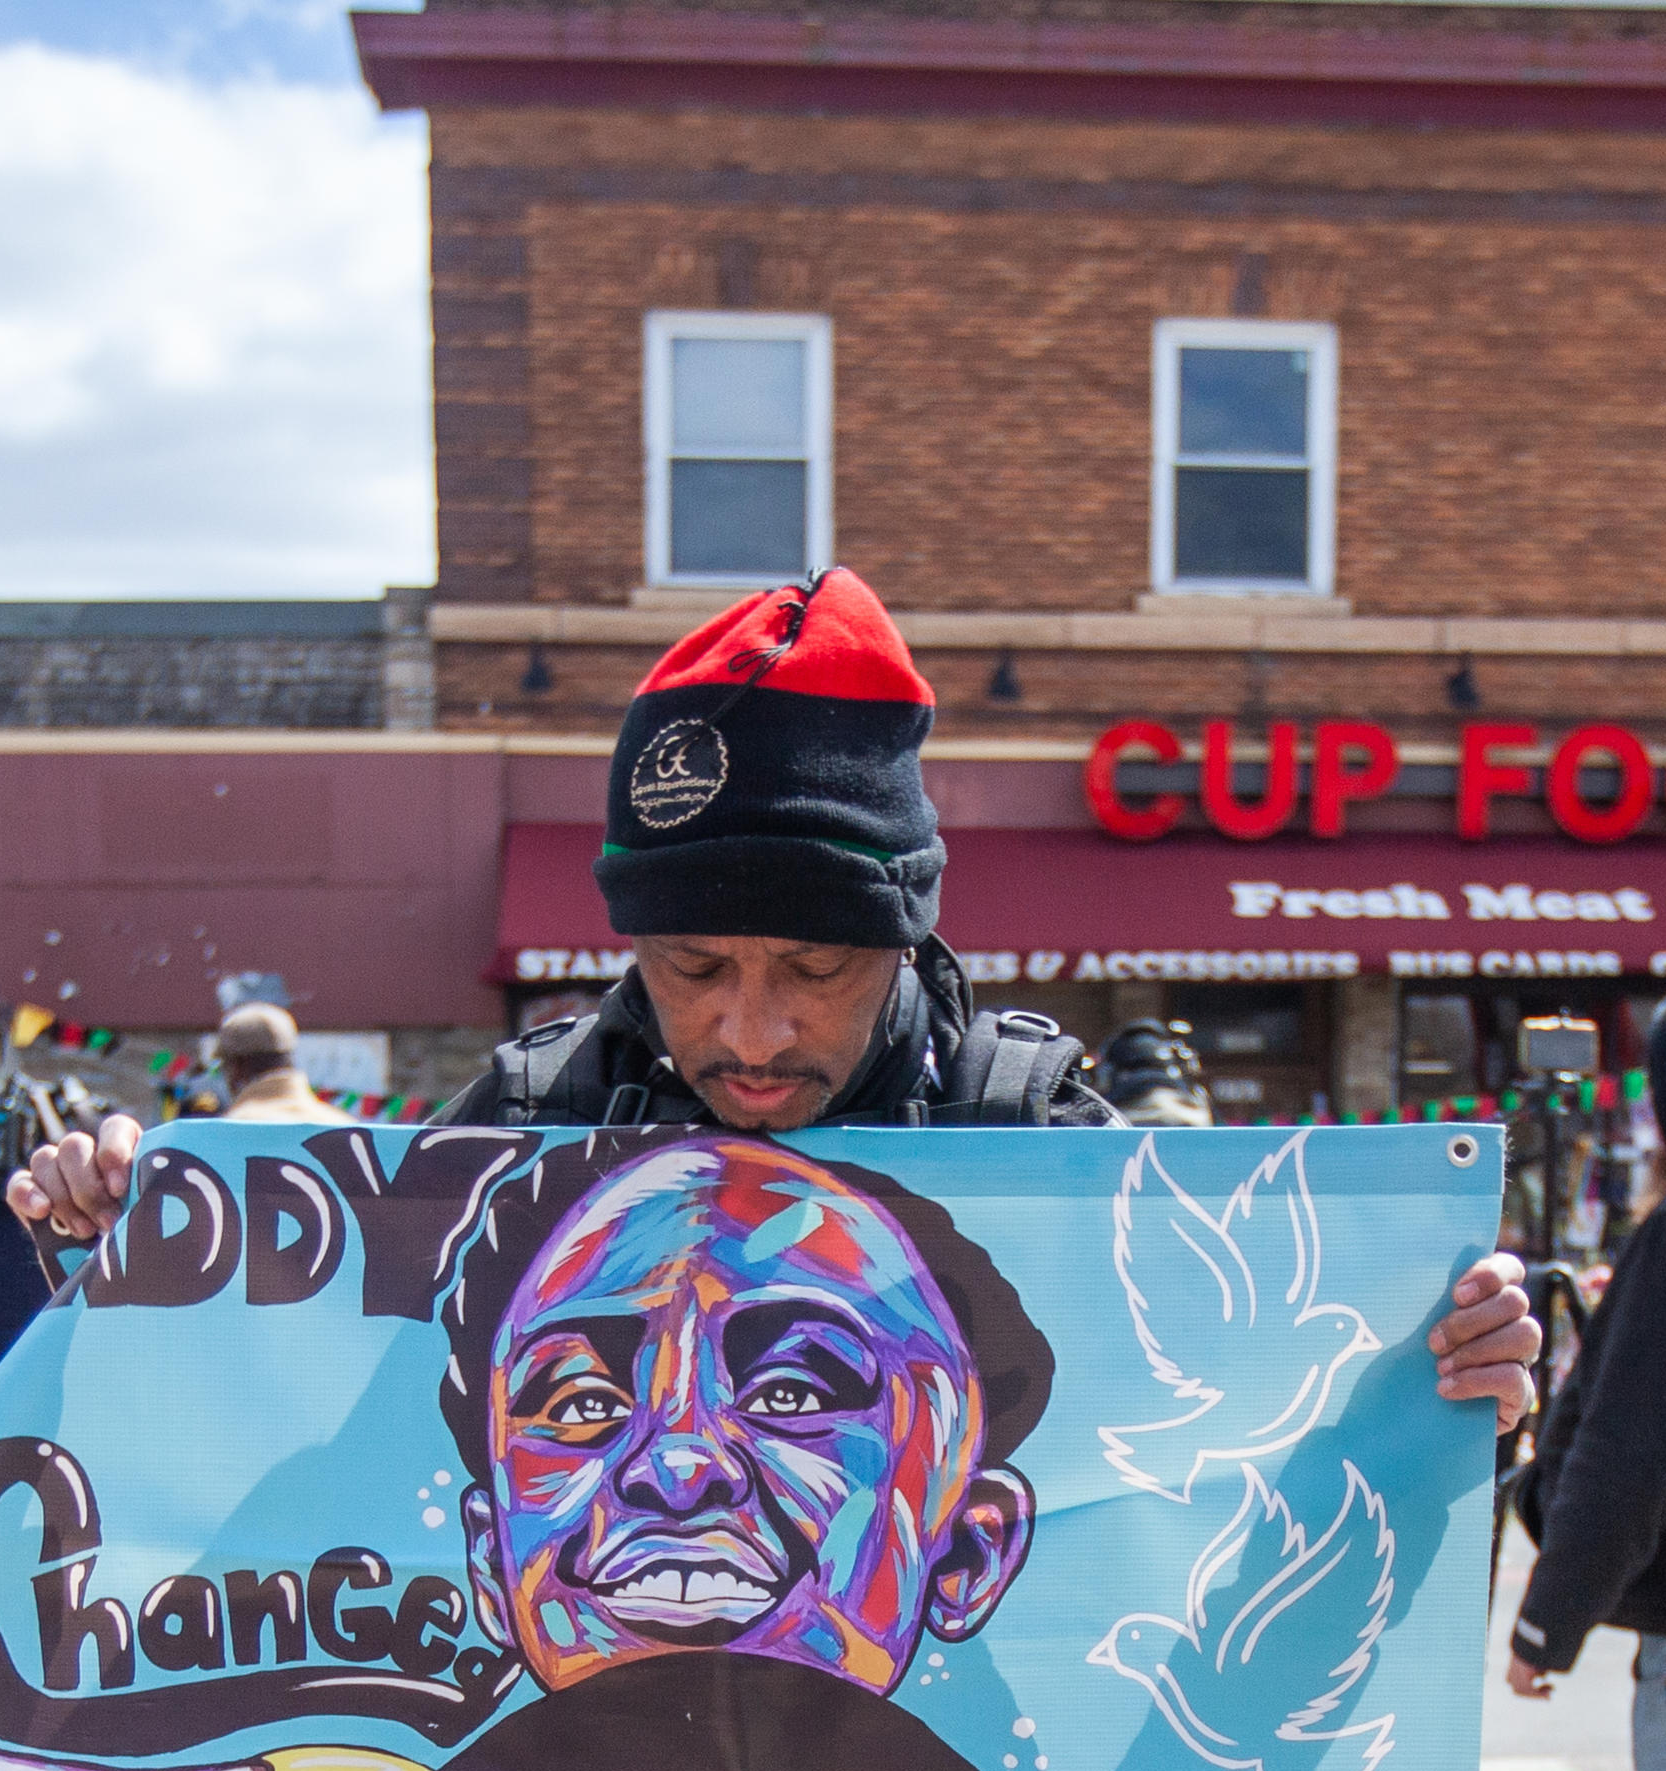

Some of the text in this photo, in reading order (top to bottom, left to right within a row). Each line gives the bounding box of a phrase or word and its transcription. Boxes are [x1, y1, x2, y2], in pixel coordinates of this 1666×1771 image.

[1084, 721, 1401, 841] CUP
[1229, 882, 1452, 919] Fresh
[1461, 883, 1655, 921] Meat
[516, 947, 637, 981] STAM
[1073, 951, 1361, 982] ACCESSORIES
[1479, 950, 1622, 977] CARDS
